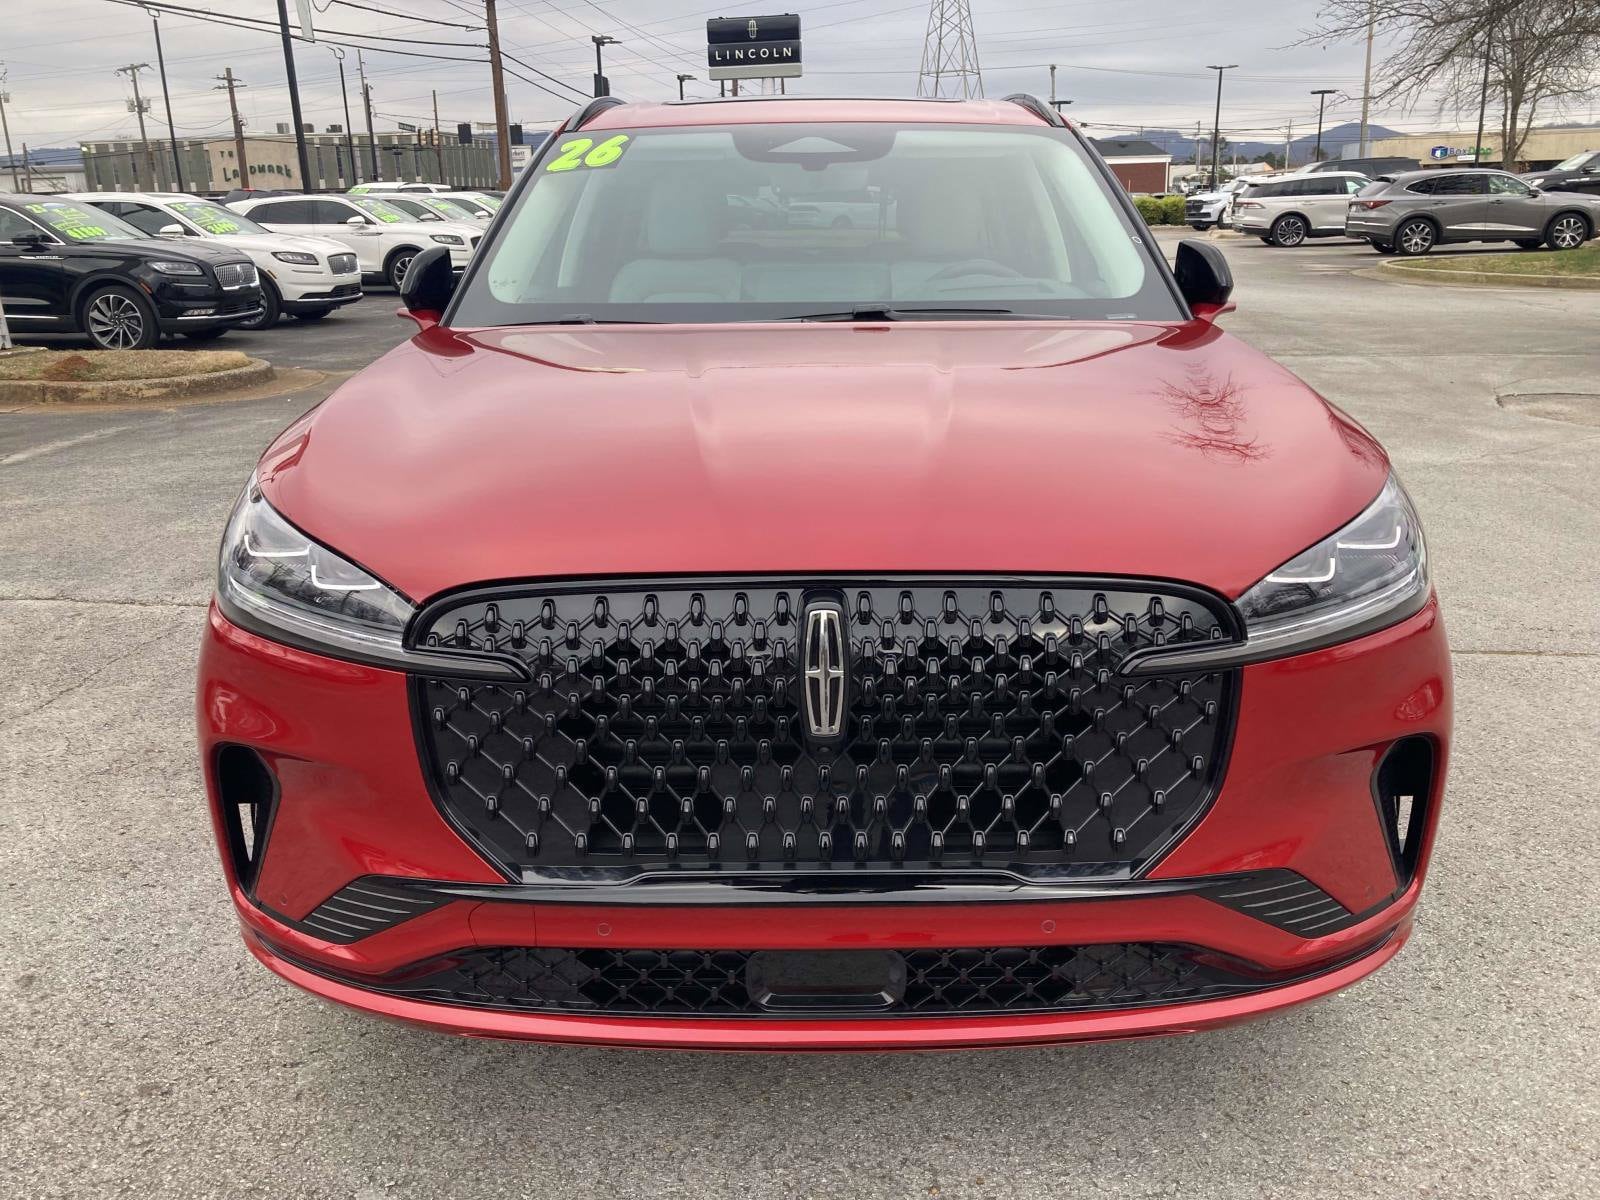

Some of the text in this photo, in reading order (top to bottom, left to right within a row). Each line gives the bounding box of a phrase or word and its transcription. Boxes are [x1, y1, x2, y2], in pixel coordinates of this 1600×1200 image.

[715, 47, 792, 60] LINCOLN
[546, 135, 630, 172] 26
[1449, 147, 1493, 158] BoxDop
[223, 164, 292, 182] LADMARK
